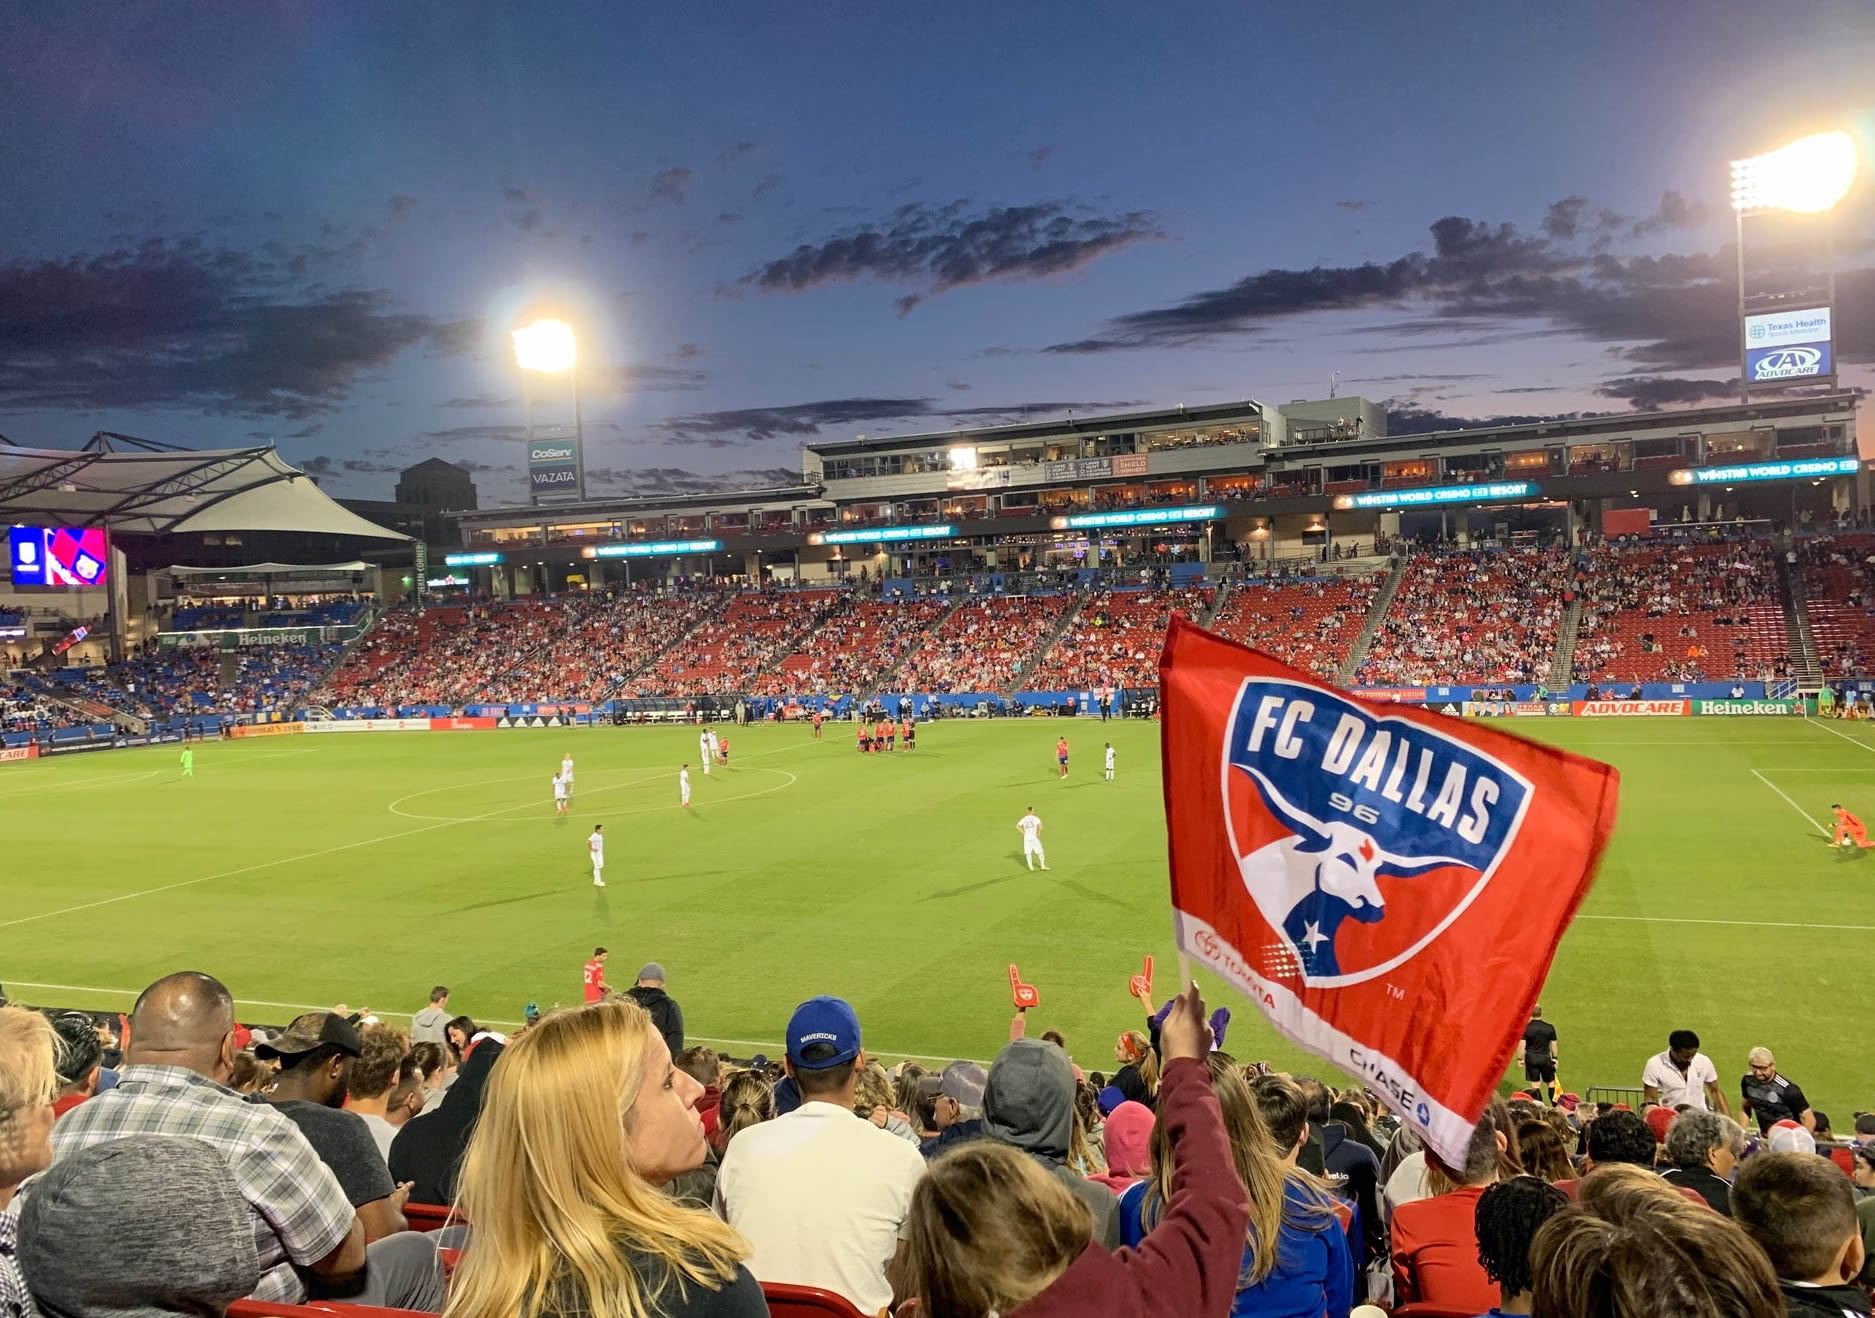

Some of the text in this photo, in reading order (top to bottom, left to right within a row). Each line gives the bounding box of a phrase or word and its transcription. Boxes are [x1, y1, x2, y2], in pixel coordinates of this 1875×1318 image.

[1768, 318, 1827, 331] Texas Health
[1757, 365, 1818, 378] ADVOCARE
[532, 448, 572, 459] CoServ
[1750, 464, 1791, 477] WORLD
[1793, 461, 1838, 474] CASINO
[532, 471, 575, 484] VAZATA
[1399, 491, 1433, 503] WORLD
[1435, 488, 1471, 499] CASINO
[1490, 484, 1528, 496] RESORT
[239, 633, 307, 647] Heineken
[1586, 701, 1683, 716] ADVOCARE
[1700, 701, 1788, 716] Heineken
[1247, 695, 1500, 844] FC DALLAS
[1328, 792, 1381, 825] 96
[1385, 983, 1405, 1000] TM
[800, 1032, 837, 1043] MAVERICKS
